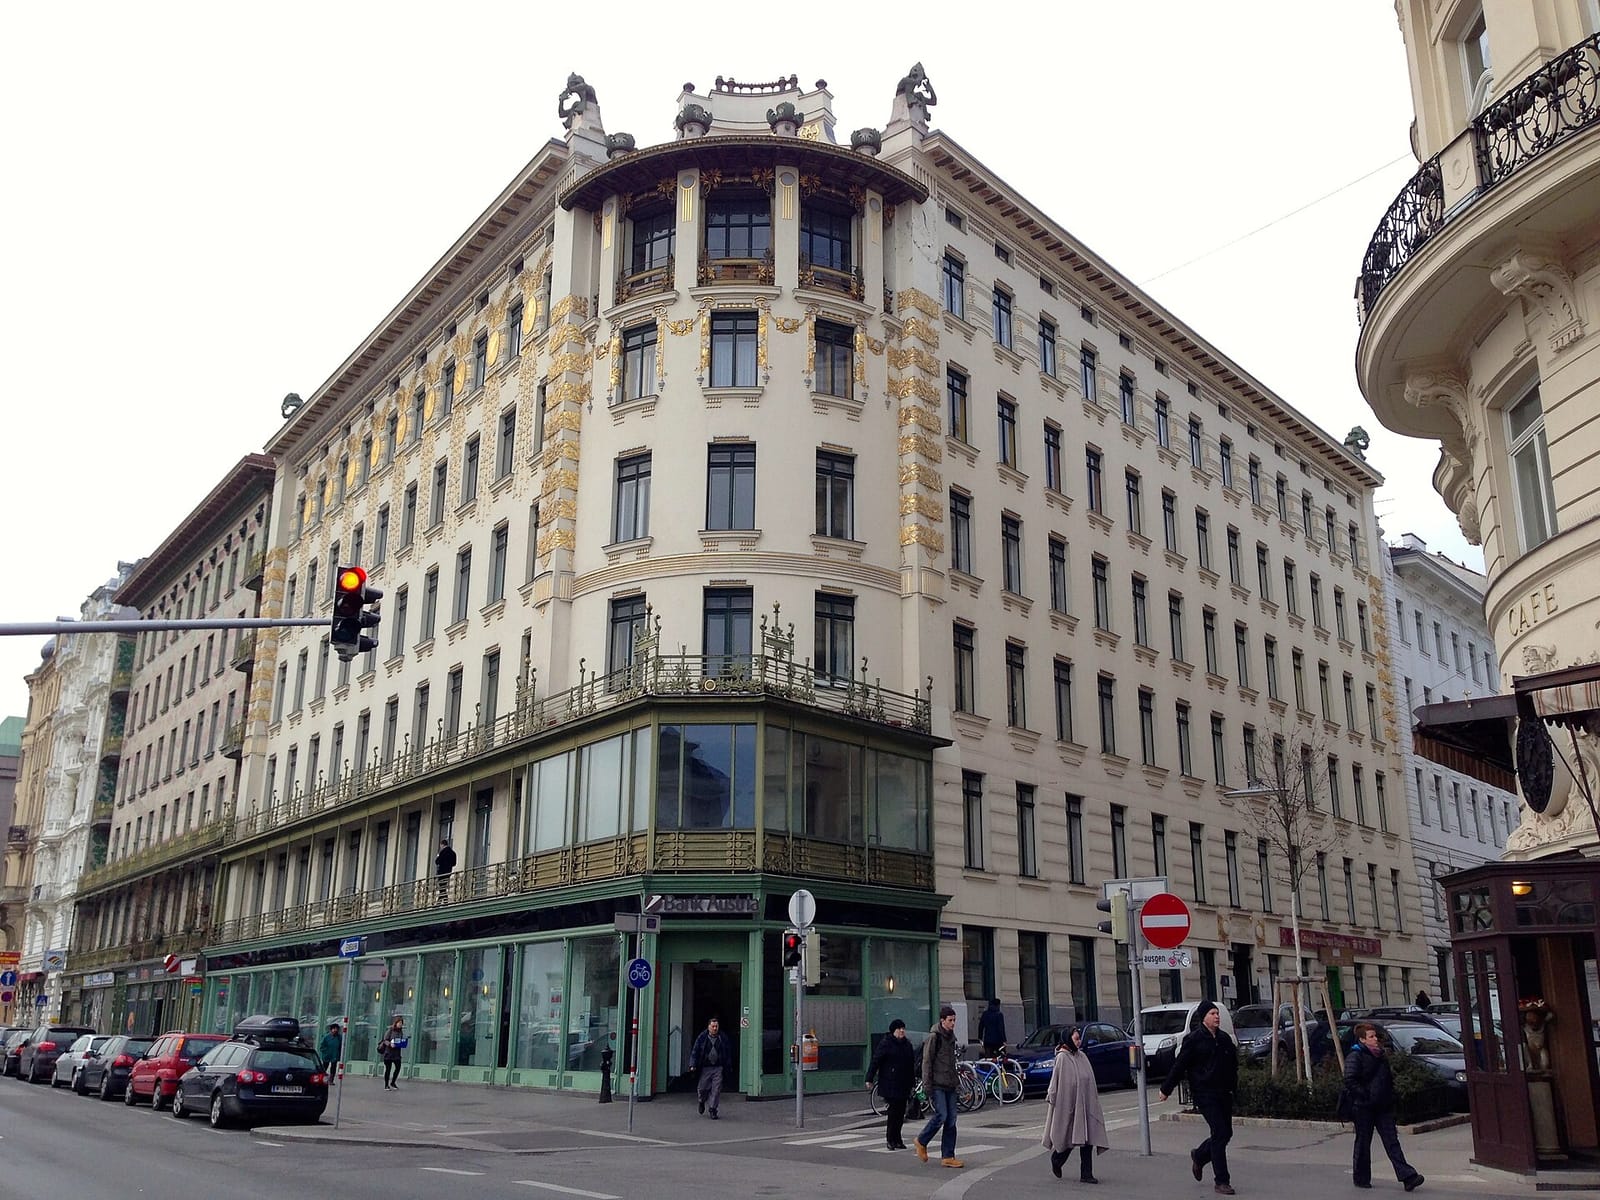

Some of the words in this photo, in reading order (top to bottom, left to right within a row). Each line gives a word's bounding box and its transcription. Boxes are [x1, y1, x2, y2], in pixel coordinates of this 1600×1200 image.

[1508, 583, 1558, 637] CAFE
[664, 895, 703, 911] Bank
[707, 895, 760, 911] Austria
[1144, 955, 1166, 965] ausgen
